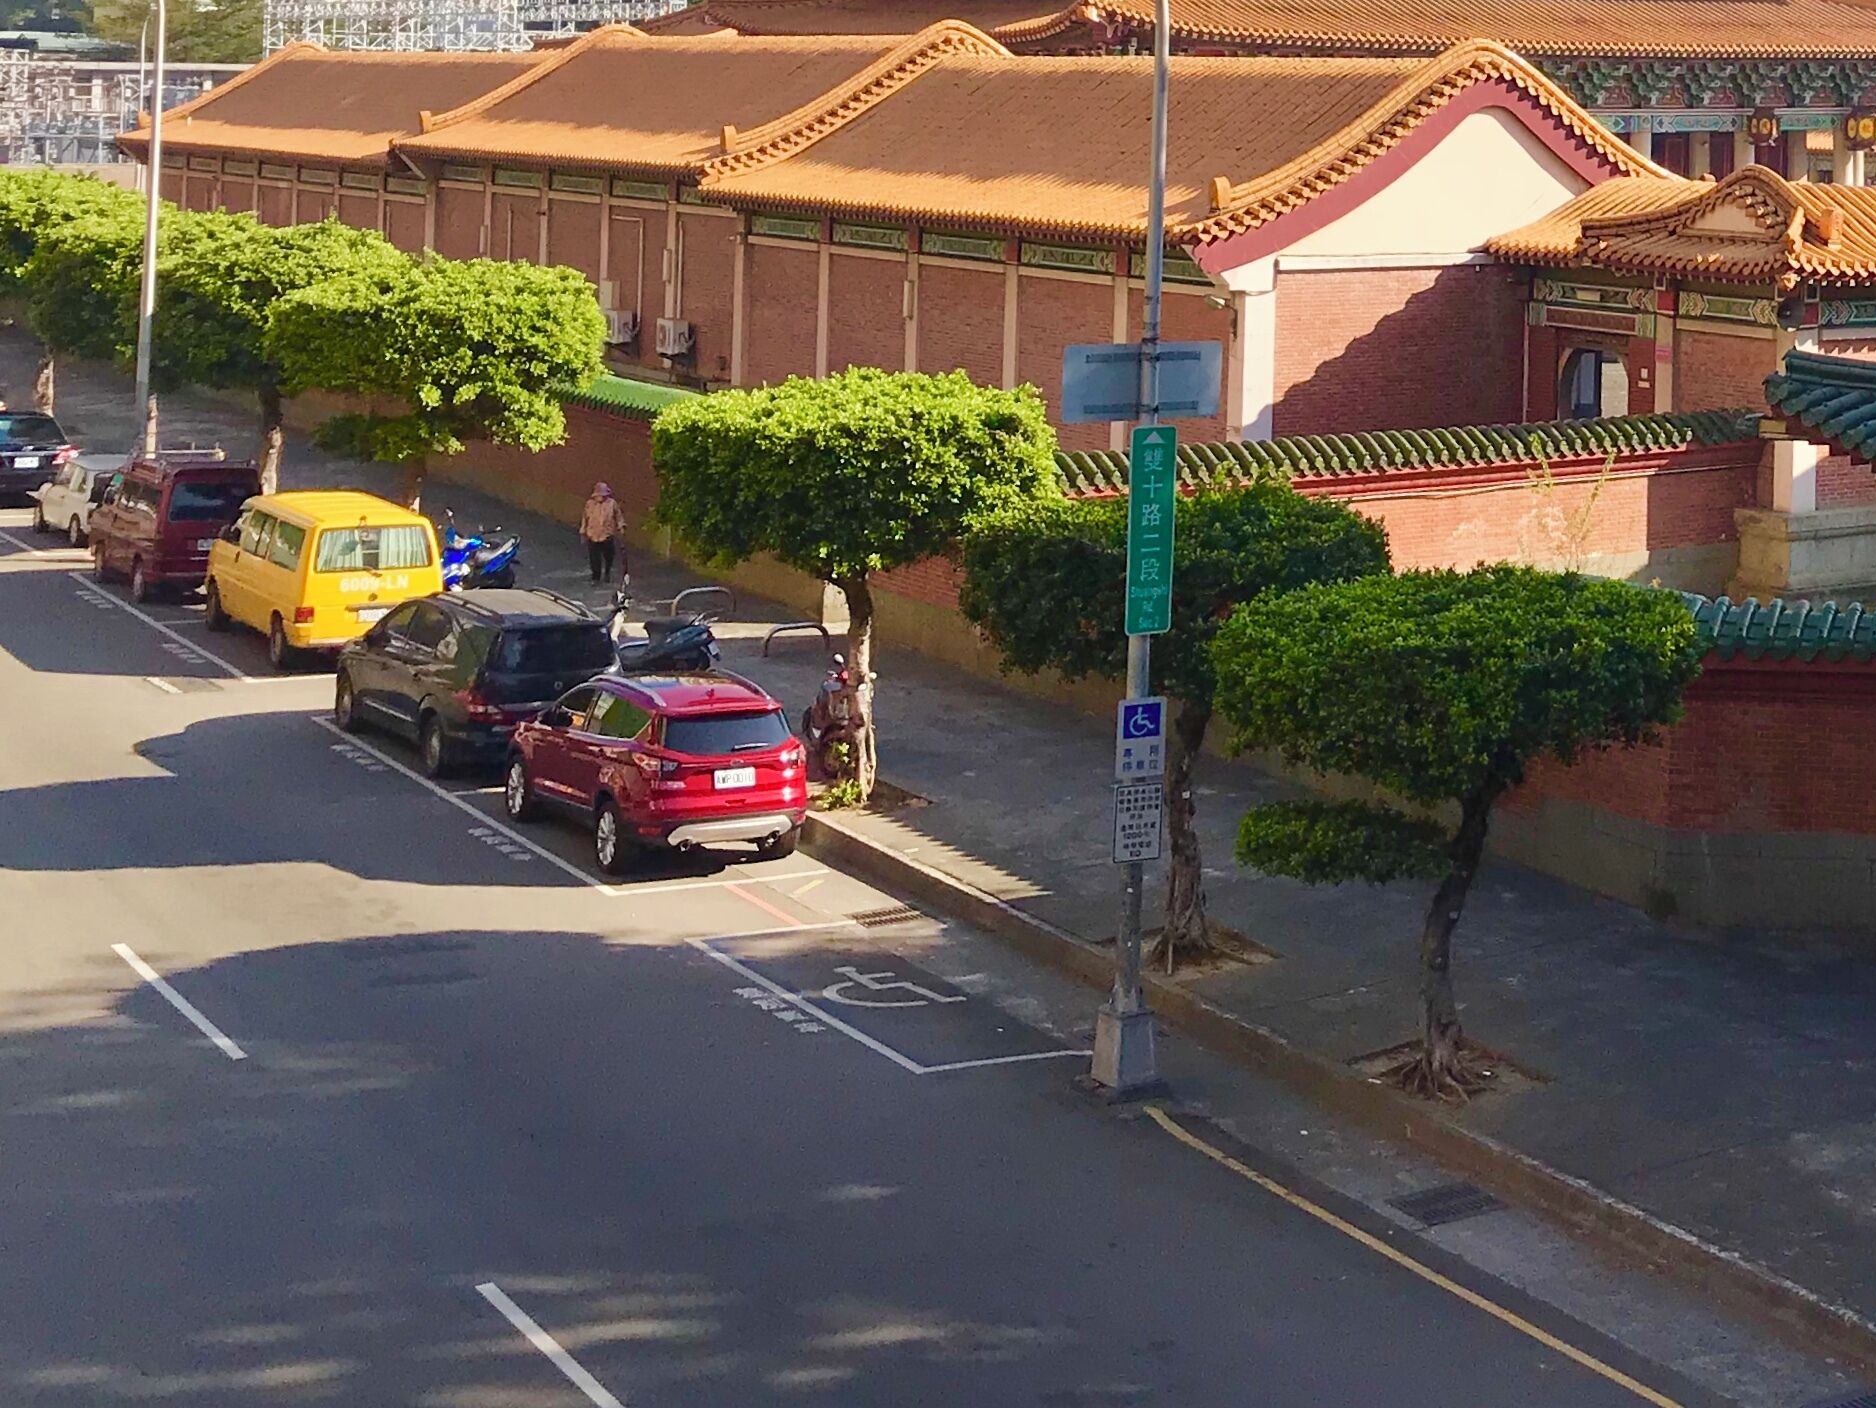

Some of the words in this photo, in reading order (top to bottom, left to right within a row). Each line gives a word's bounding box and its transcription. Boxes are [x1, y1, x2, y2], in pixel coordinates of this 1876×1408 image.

[1140, 448, 1164, 581] 雙十路二段
